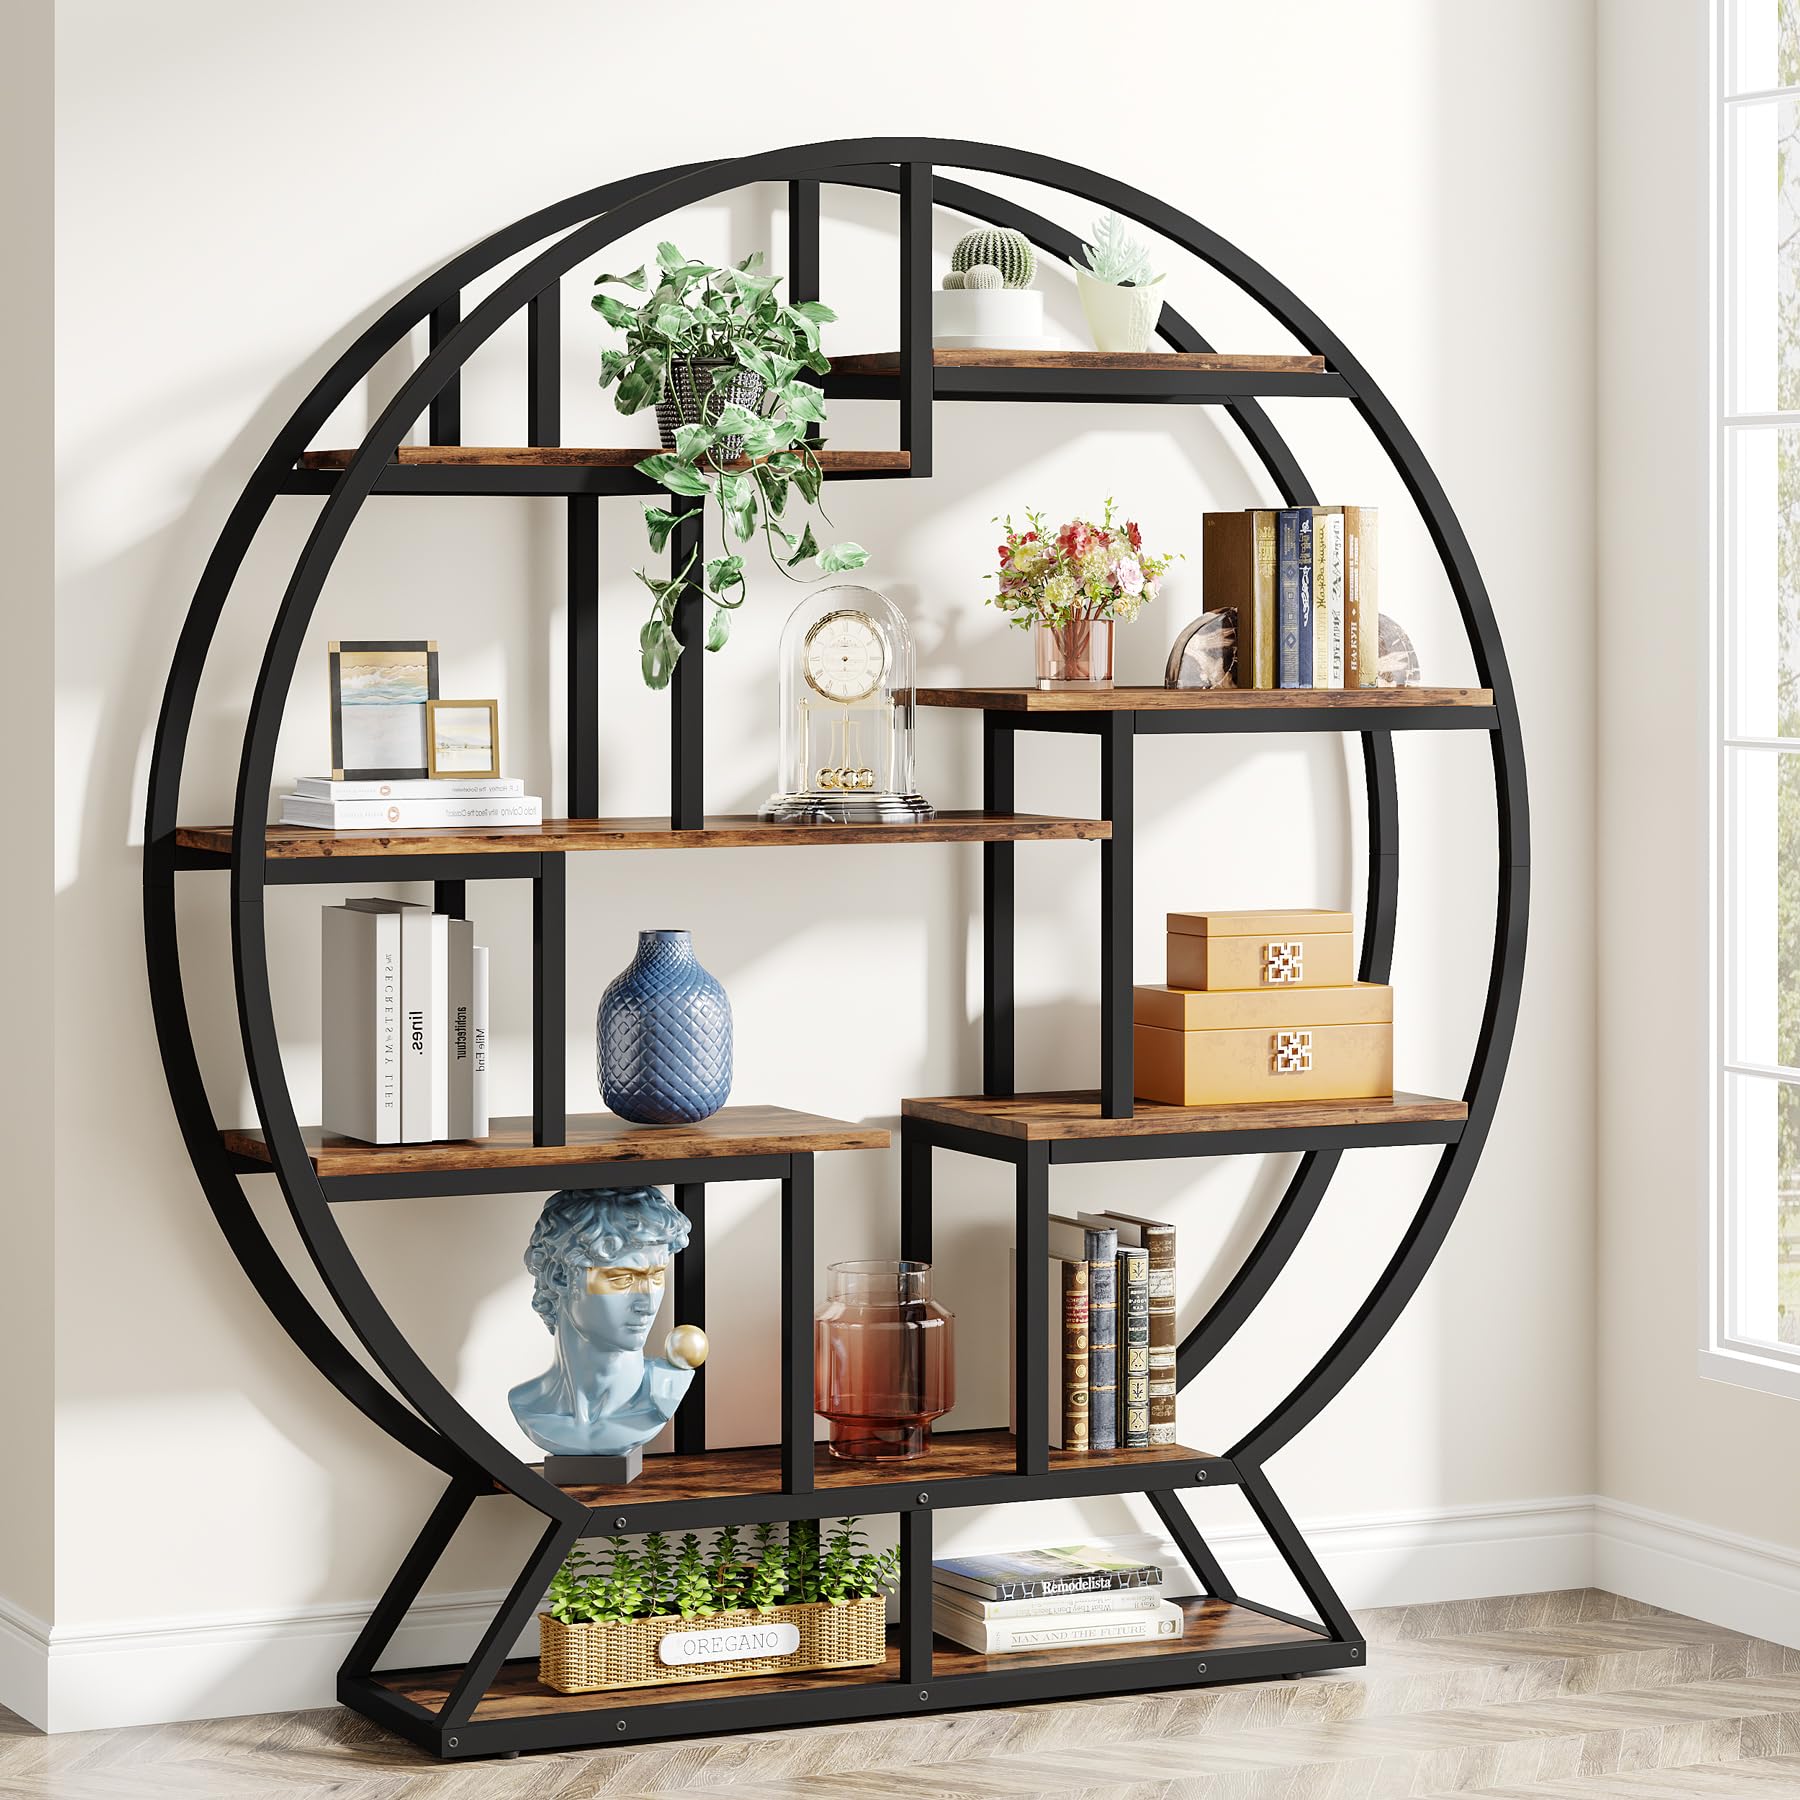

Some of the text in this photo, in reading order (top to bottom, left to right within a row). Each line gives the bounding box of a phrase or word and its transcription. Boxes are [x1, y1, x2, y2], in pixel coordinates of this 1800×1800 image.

[1042, 1577, 1112, 1595] Remodelista
[683, 1631, 779, 1656] OREGANO
[1011, 1625, 1146, 1645] MAN AND THE FUTURE
